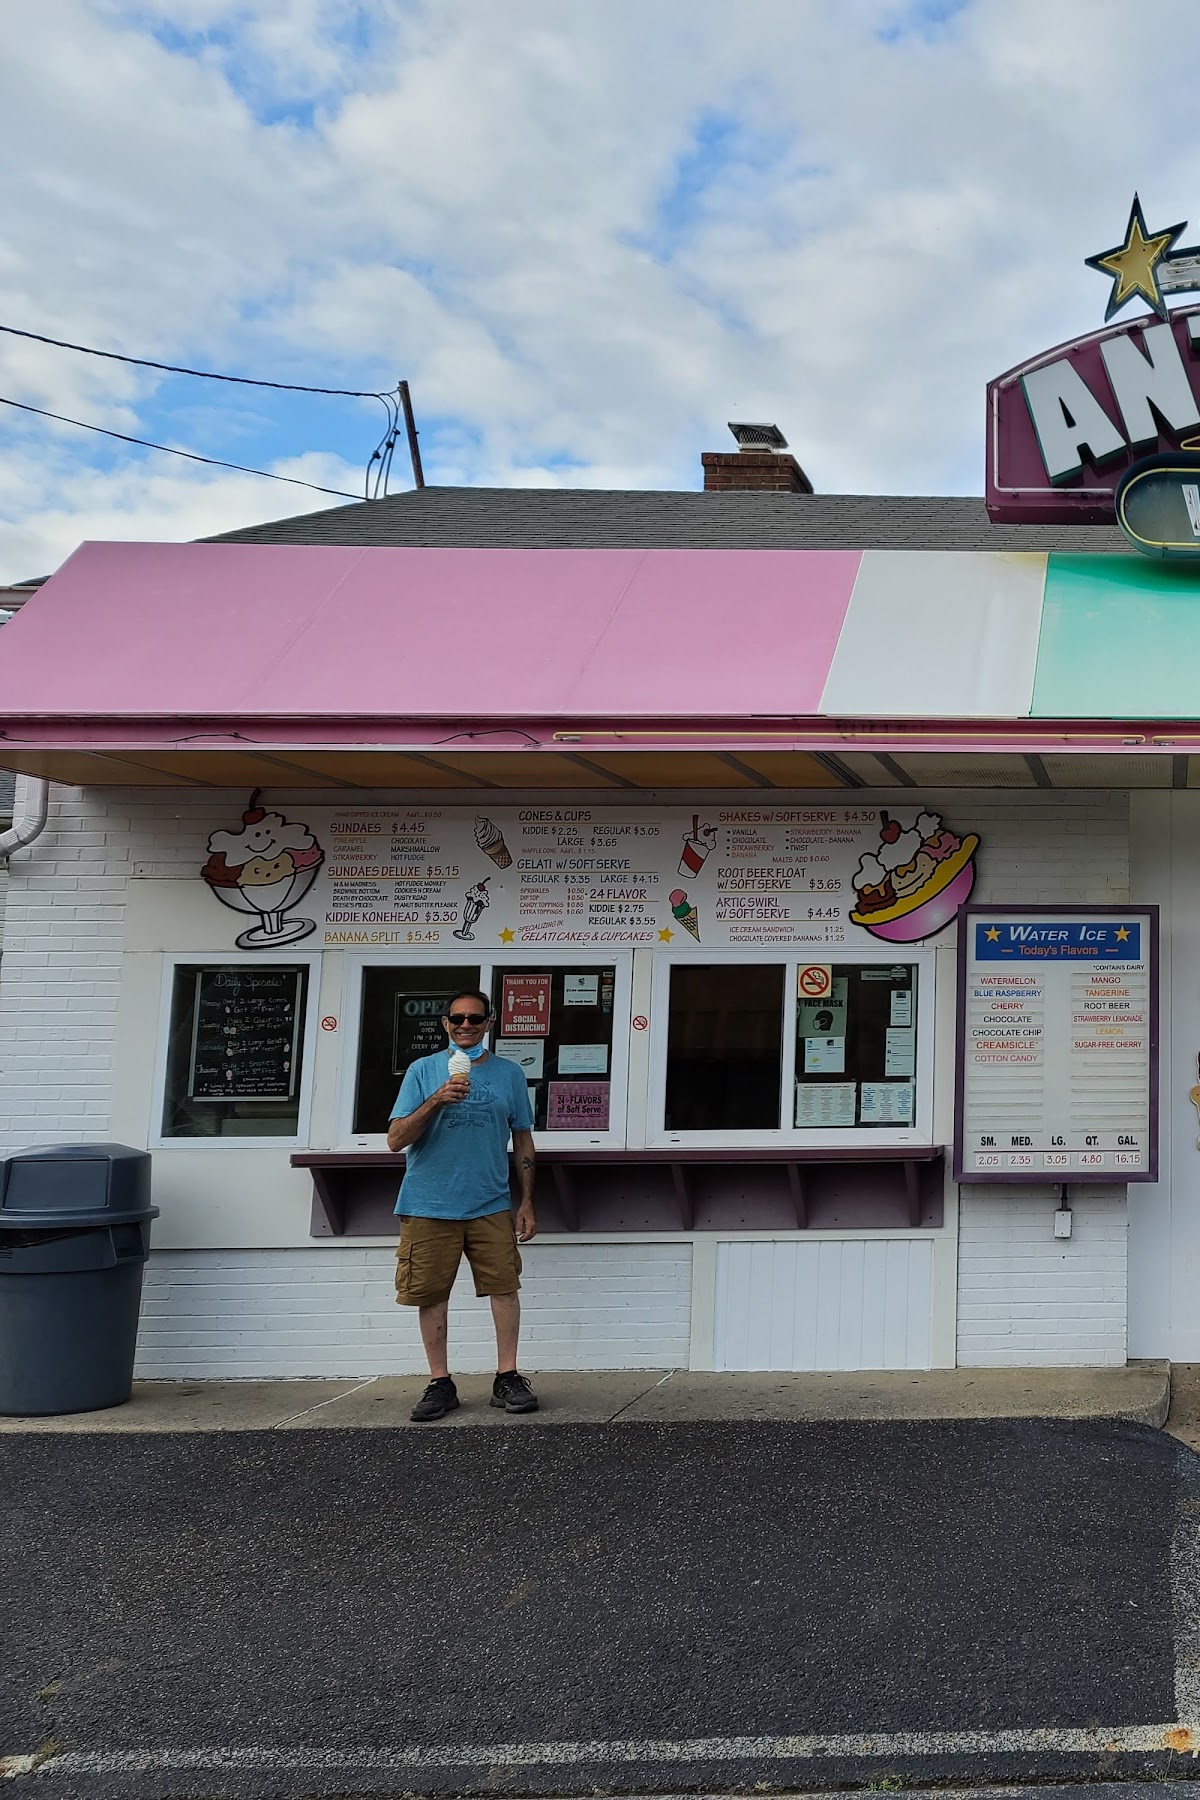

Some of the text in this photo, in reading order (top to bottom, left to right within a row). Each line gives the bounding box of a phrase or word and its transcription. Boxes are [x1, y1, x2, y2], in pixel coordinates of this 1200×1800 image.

[519, 811, 591, 821] CONES & CUPS
[720, 811, 875, 822] SHAKES w/ SOFT SERVE $4.30
[330, 822, 424, 834] SUNDAES $4.45
[523, 827, 548, 835] KIDDIE
[593, 827, 660, 835] REGULAR $3.05
[517, 859, 630, 869] GELATI w/ SOFT SERVE
[328, 866, 459, 878] SUNDAES DELUXE $5.15
[718, 868, 806, 878] ROOT BEER FLOAT
[521, 875, 590, 884] REGULAR $3.35
[600, 875, 659, 884] LARGE $4.15
[718, 879, 841, 890] w/ SOFT SERVE $3.65
[590, 889, 647, 899] 24 FLAVOR
[716, 898, 780, 907] ARTIC SWIRL
[589, 904, 644, 913] KIDDIE $2.75
[716, 908, 840, 919] w/ SOFT SERVE $4.45
[326, 911, 457, 923] KIDDIE KONEHEAD $3.30
[589, 917, 656, 925] REGULAR $3.55
[518, 921, 555, 932] SPECIALIZING
[325, 930, 440, 942] BANANA SPLIT $5.45
[522, 932, 653, 941] GELATI CAKES & CUPCAKES
[1009, 926, 1107, 941] WATER ICE
[1018, 945, 1098, 957] Today's Flavors
[214, 973, 241, 996] Daily
[567, 1105, 580, 1113] Soft
[981, 1136, 1138, 1146] SM. MED. LG. QT. GAL.
[979, 1154, 1140, 1165] 2.05 2.35 3.05 4.80 16.15
